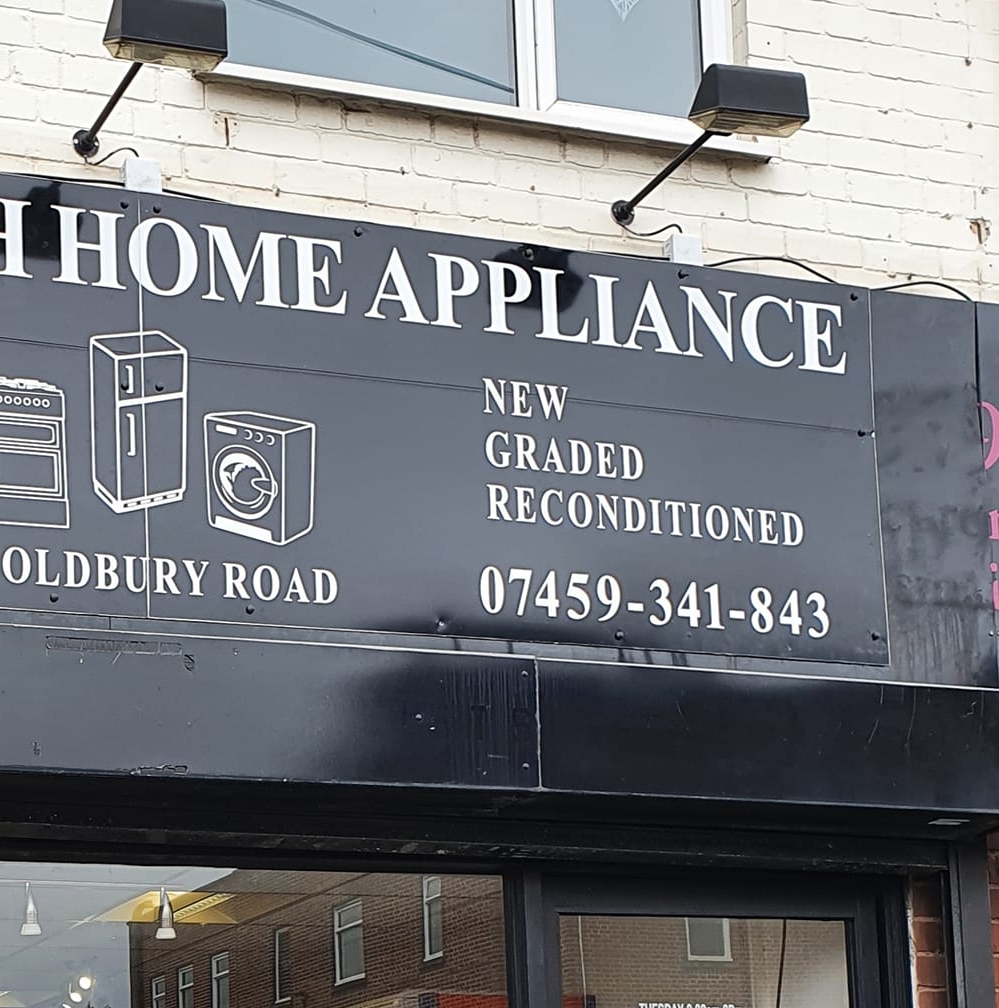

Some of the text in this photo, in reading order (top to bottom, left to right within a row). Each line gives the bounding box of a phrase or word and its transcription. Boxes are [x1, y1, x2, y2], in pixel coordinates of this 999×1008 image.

[50, 204, 348, 316] HOME
[363, 246, 848, 375] APPLIANCE
[482, 377, 569, 422] NEW
[485, 431, 645, 481] GRADED
[486, 483, 805, 548] RECONDITIONED
[1, 546, 210, 597] OLDBURY
[222, 562, 339, 605] ROAD
[478, 565, 831, 639] 07459-341-843
